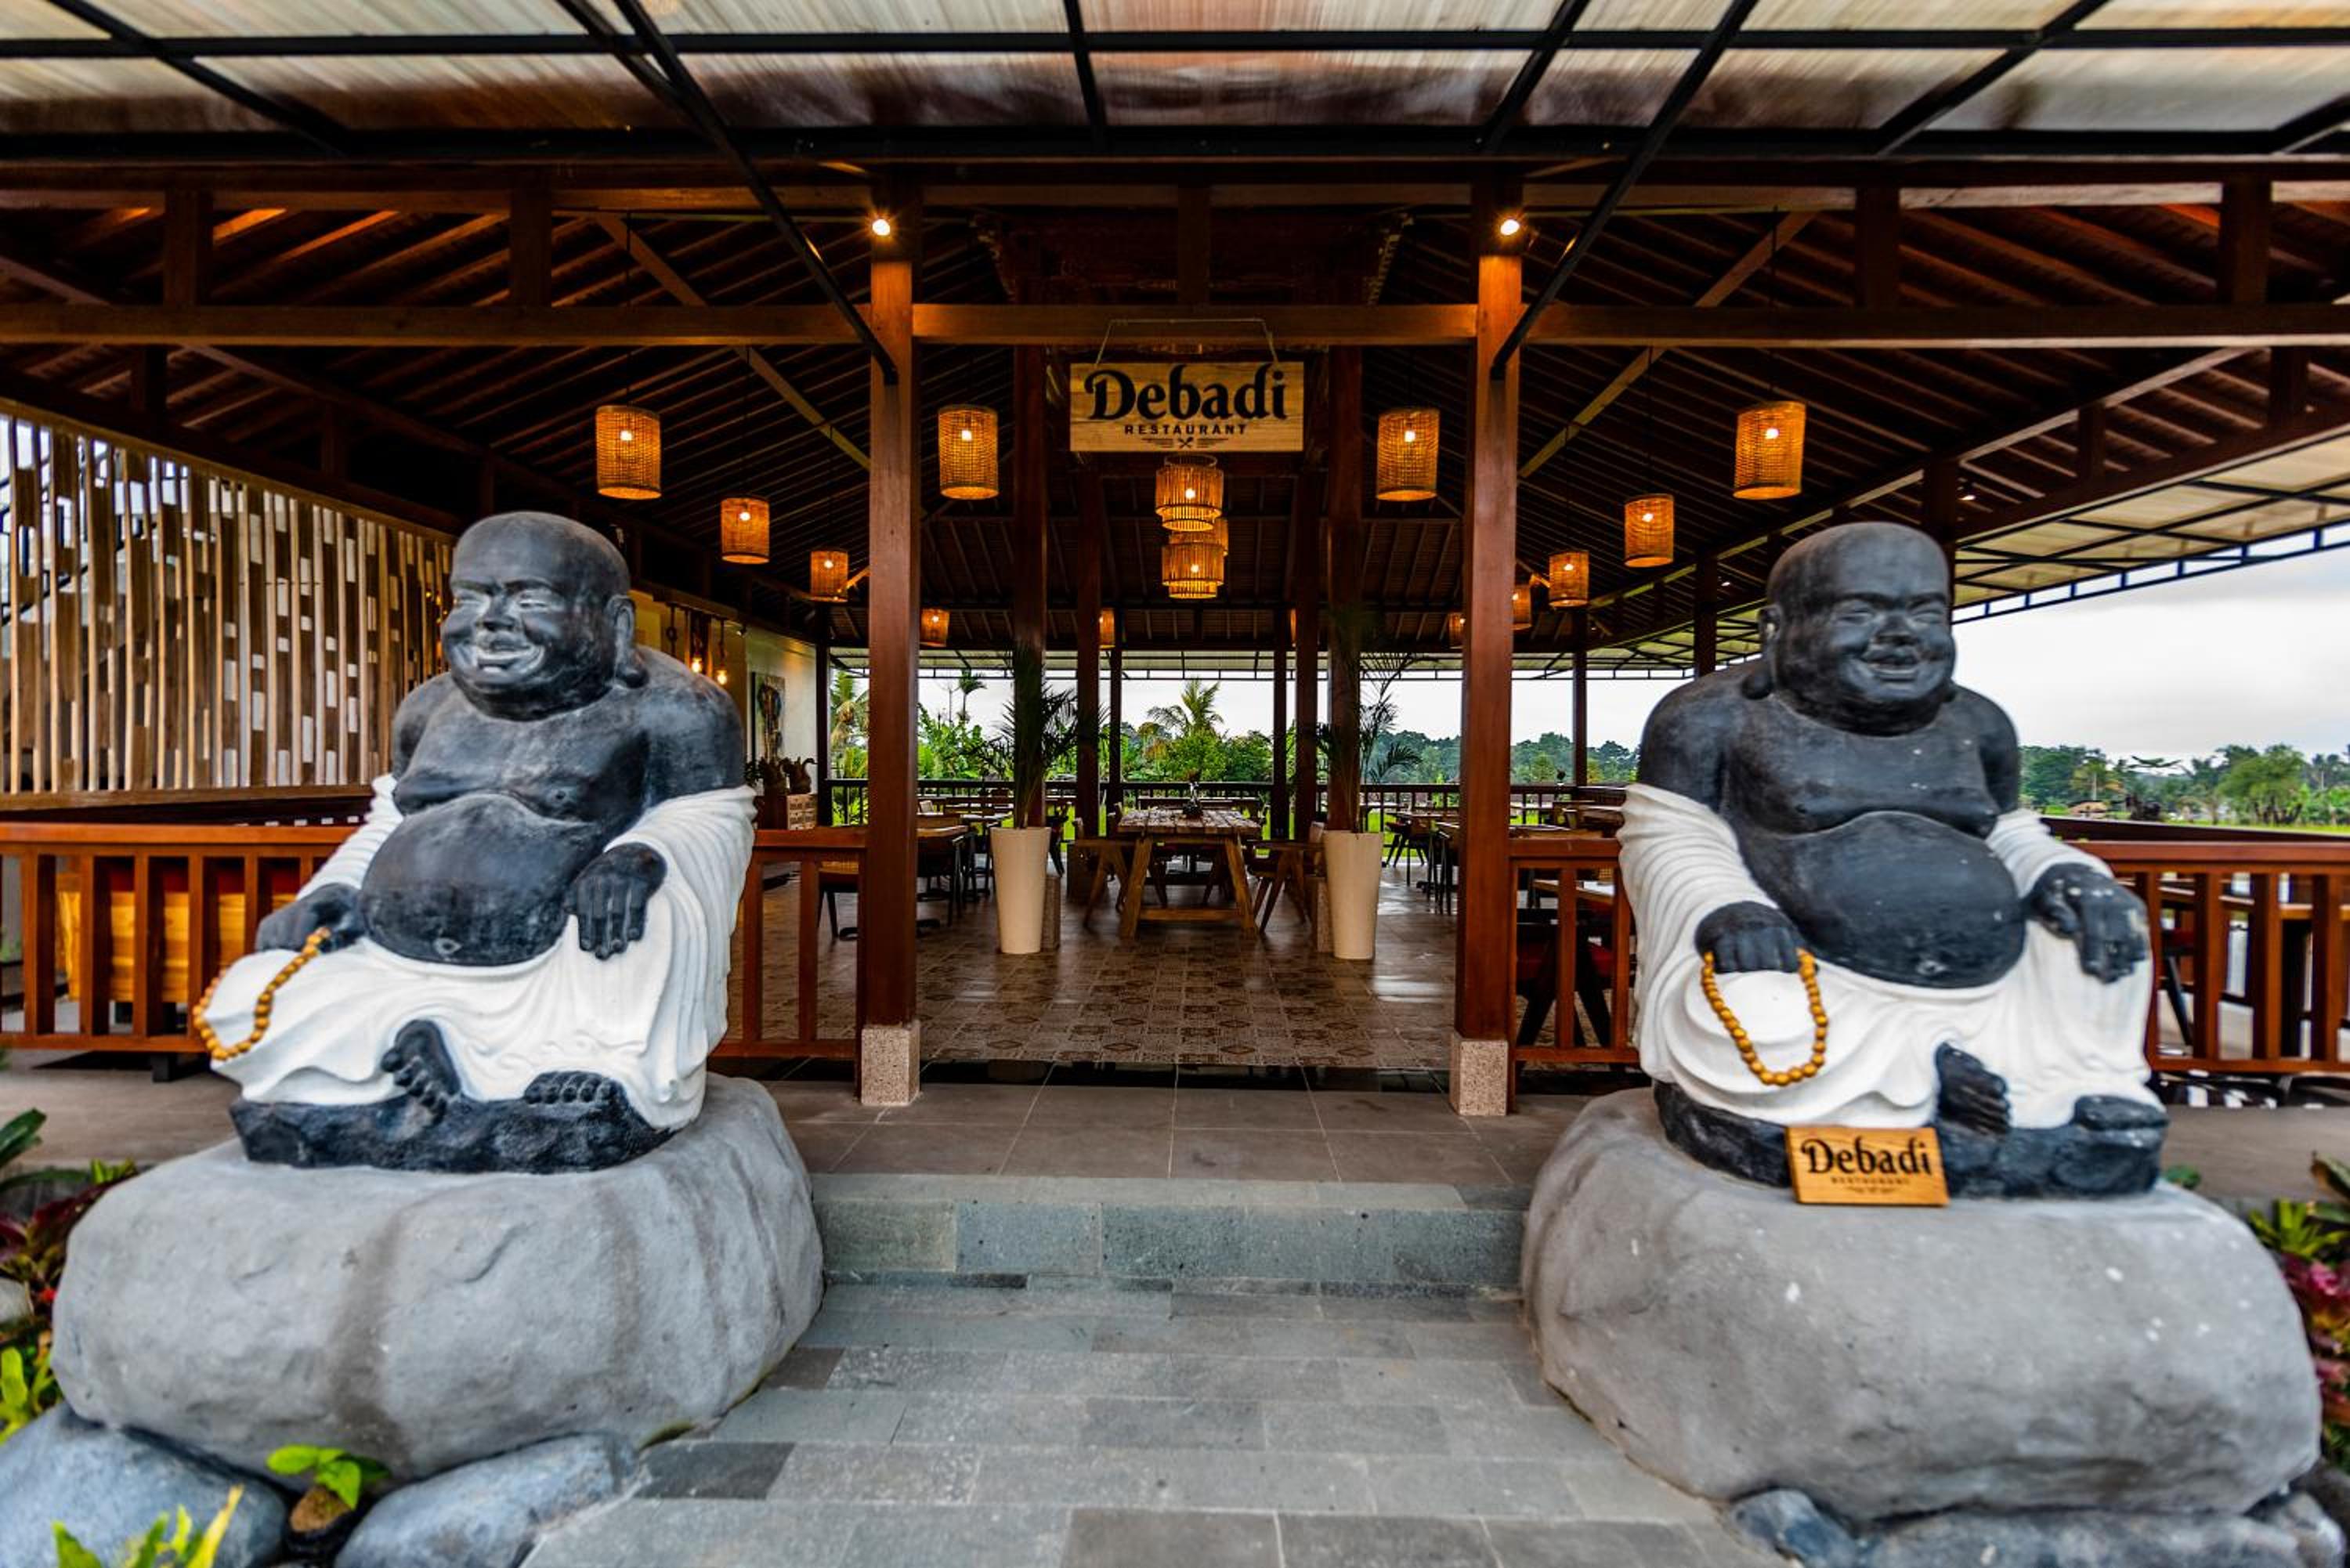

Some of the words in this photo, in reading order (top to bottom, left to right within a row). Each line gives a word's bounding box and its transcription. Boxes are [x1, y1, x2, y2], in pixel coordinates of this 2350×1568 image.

[1084, 363, 1287, 420] Debadi
[1124, 424, 1247, 435] RESTAURANT
[1800, 1136, 1932, 1175] Debadi
